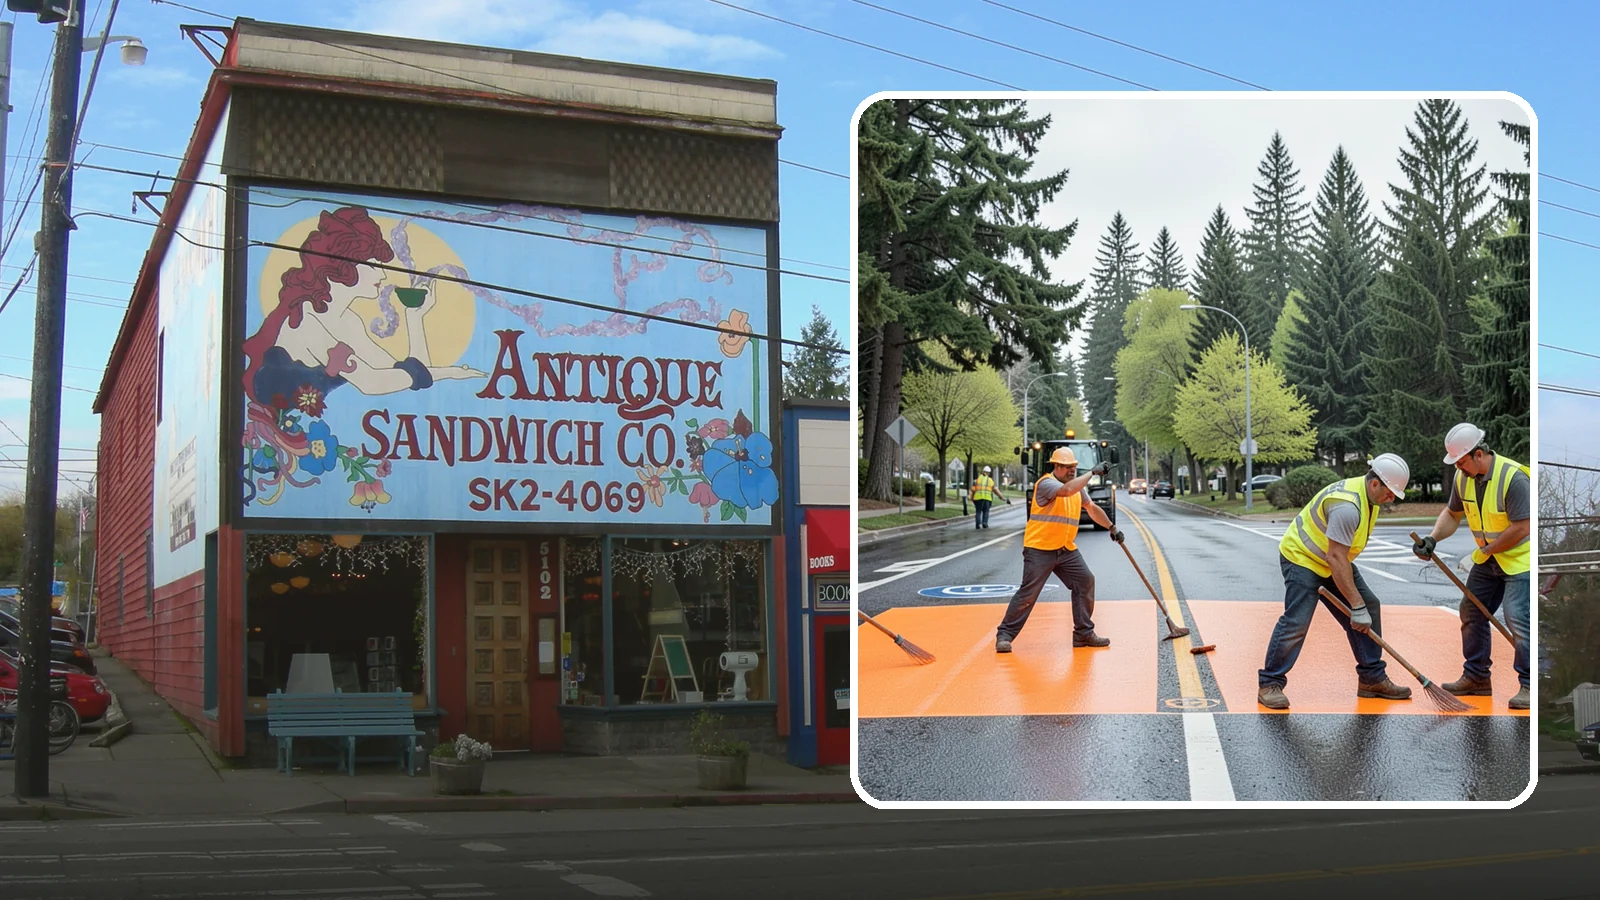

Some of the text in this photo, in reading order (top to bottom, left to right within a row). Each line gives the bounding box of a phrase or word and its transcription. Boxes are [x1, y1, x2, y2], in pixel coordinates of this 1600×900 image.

[475, 329, 724, 421] ANTIQUE
[361, 408, 685, 469] SANDWICH CO.
[468, 477, 646, 513] SK2-4069
[540, 541, 551, 600] 5102
[810, 555, 835, 569] BOOKS
